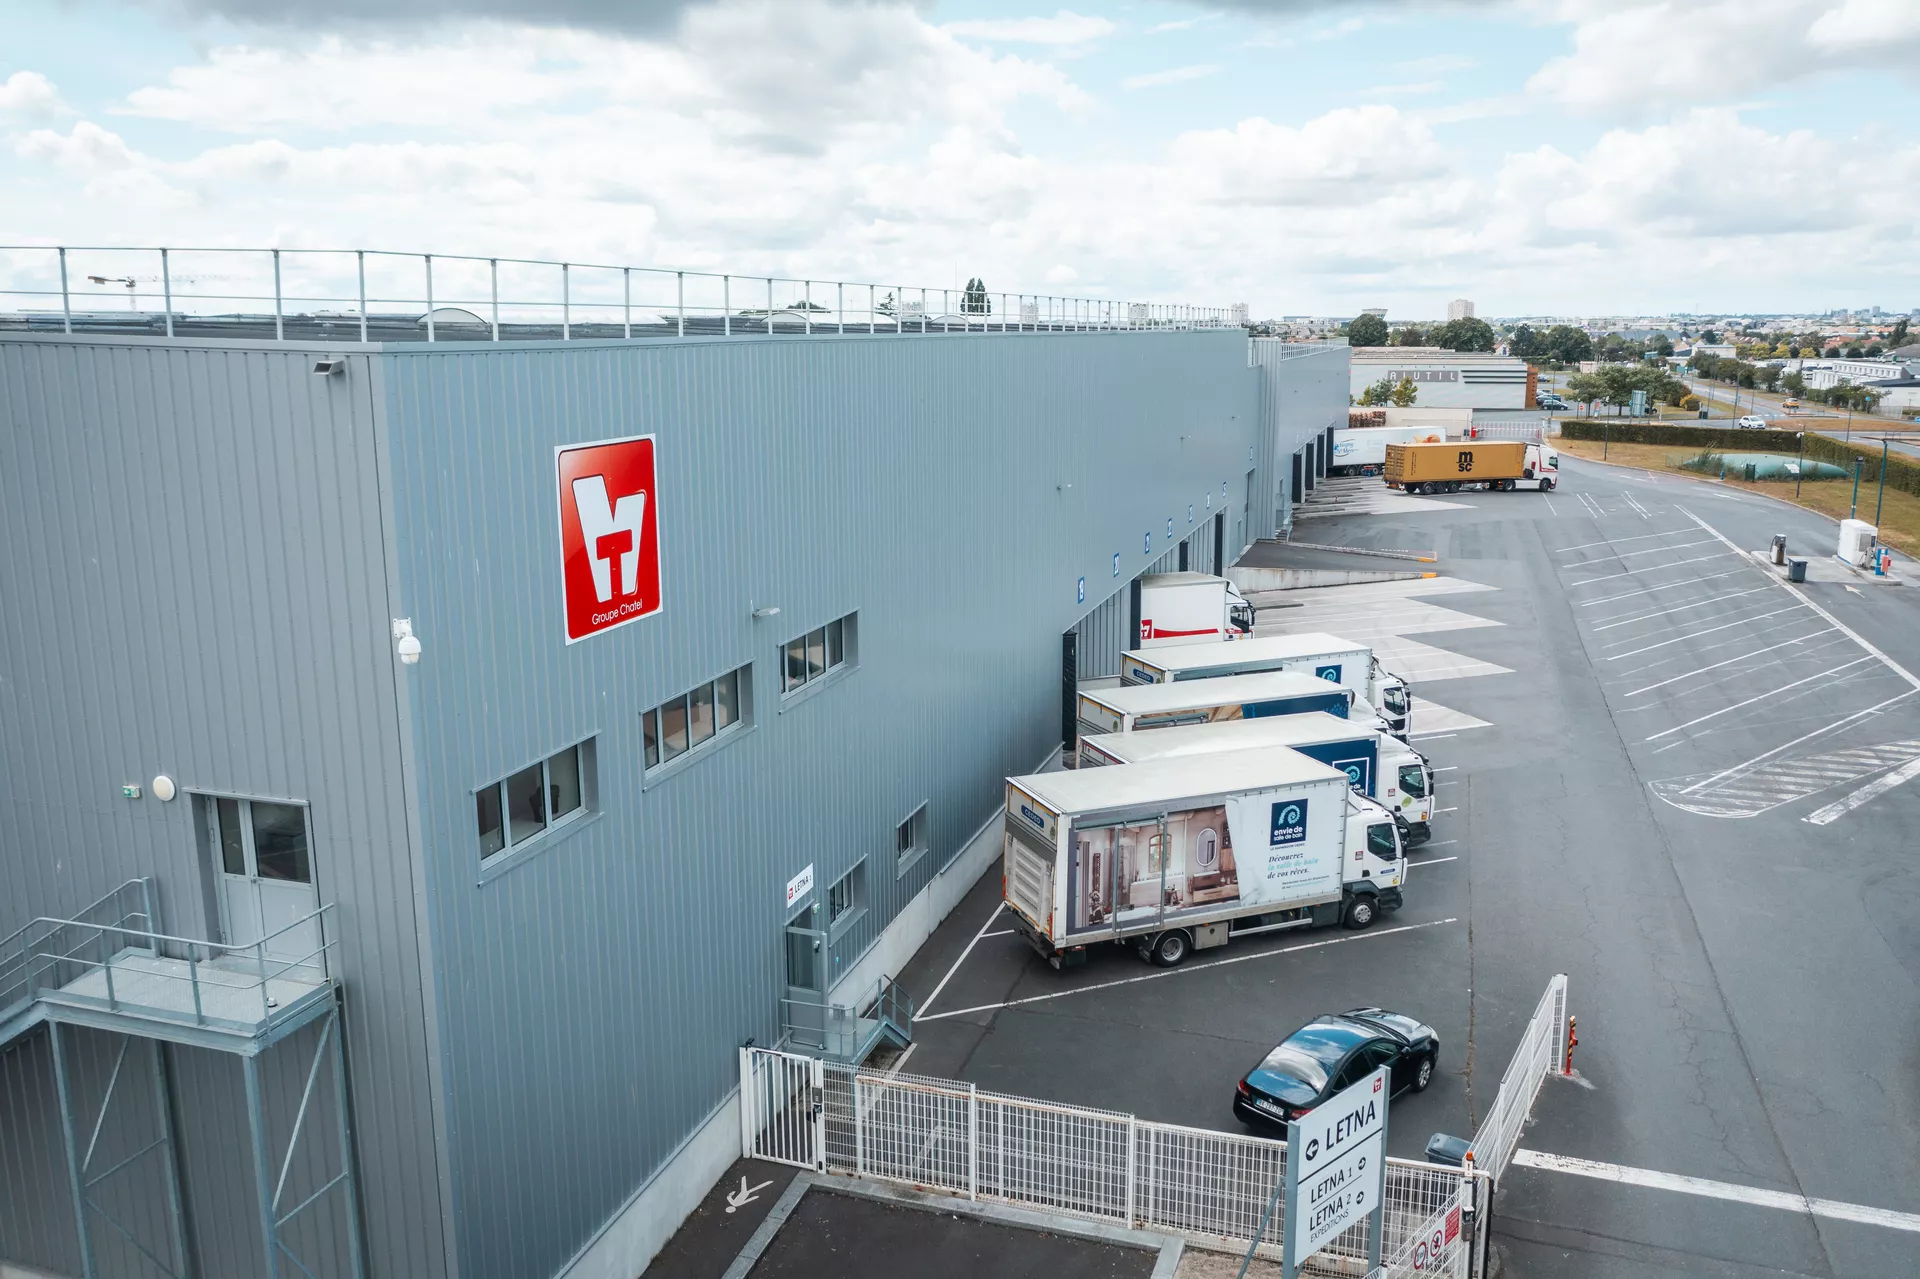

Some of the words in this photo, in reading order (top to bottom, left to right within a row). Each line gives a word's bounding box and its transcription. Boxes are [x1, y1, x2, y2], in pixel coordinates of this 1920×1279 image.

[591, 609, 619, 625] Groupe
[619, 598, 643, 615] Chatel
[1024, 808, 1041, 824] CEDEO
[1273, 827, 1293, 836] envie
[1293, 825, 1303, 833] de
[1267, 872, 1276, 880] de
[1325, 1100, 1376, 1151] LETNA
[1311, 1169, 1345, 1204] LETNA
[1347, 1167, 1352, 1178] 1
[1309, 1196, 1343, 1232] LETNA
[1346, 1193, 1352, 1205] 2
[1310, 1209, 1349, 1243] EXPEDITIONS
